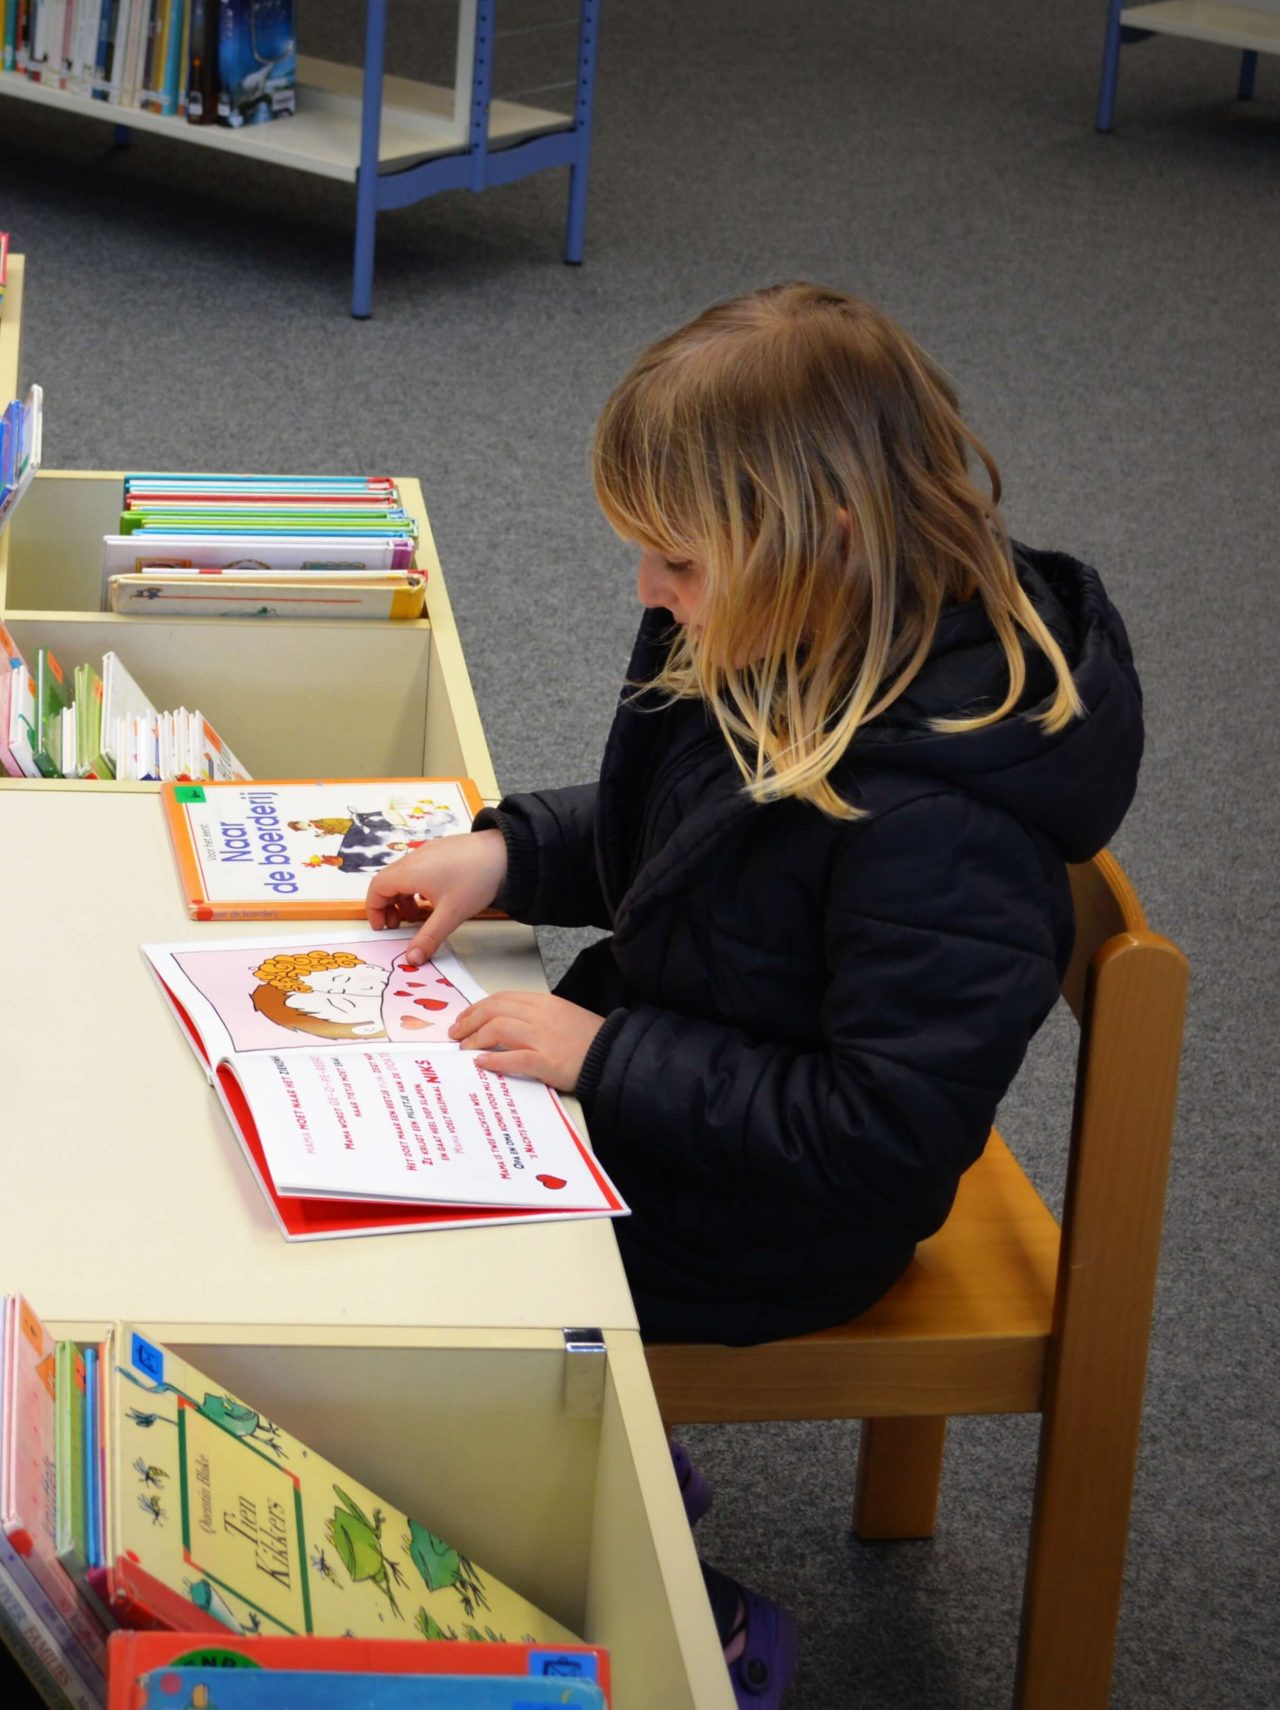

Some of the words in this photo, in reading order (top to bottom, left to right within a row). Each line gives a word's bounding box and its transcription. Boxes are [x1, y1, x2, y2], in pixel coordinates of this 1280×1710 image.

[200, 824, 212, 838] eerst
[239, 792, 291, 865] boerderij
[203, 838, 214, 849] het
[219, 821, 254, 862] Naar
[208, 848, 217, 861] Voor
[263, 871, 299, 894] de
[336, 1067, 350, 1082] MOET
[391, 1072, 401, 1080] DE
[414, 1059, 442, 1085] NIKS
[281, 1076, 295, 1089] HET
[395, 1081, 406, 1093] VAN
[480, 1080, 493, 1093] MIJ
[499, 1081, 512, 1098] PAPA
[286, 1089, 302, 1109] NAAR
[380, 1089, 396, 1110] BEETJE
[400, 1095, 416, 1120] PILLETJE
[432, 1086, 450, 1115] HELEMAAL
[485, 1092, 499, 1110] VOOR
[505, 1097, 518, 1108] BIJ
[293, 1110, 309, 1131] MOET
[333, 1108, 349, 1129] WORDT
[388, 1110, 400, 1122] EEN
[422, 1106, 435, 1120] DIEP
[494, 1110, 508, 1132] KOMEN
[509, 1108, 520, 1117] IK
[410, 1120, 422, 1132] EEN
[427, 1121, 440, 1134] HEEL
[442, 1115, 457, 1134] VOELT
[474, 1107, 493, 1137] NACHTJES
[512, 1115, 526, 1129] MAG
[392, 1122, 406, 1140] MAAR
[502, 1132, 515, 1147] OMA
[301, 1132, 318, 1155] MAMA
[399, 1140, 413, 1157] DOET
[414, 1133, 430, 1156] KRIJGT
[433, 1135, 447, 1152] GAAT
[486, 1136, 500, 1153] TWEE
[508, 1146, 520, 1155] EN
[405, 1158, 418, 1172] HET
[421, 1157, 434, 1166] ZE
[439, 1152, 451, 1161] EN
[492, 1153, 504, 1161] IS
[512, 1156, 525, 1170] OPA
[195, 1452, 211, 1486] Blake
[198, 1484, 217, 1536] Quentin
[223, 1494, 261, 1547] Tien
[255, 1496, 293, 1592] Kikkers
[23, 1623, 71, 1687] FAMILIES
